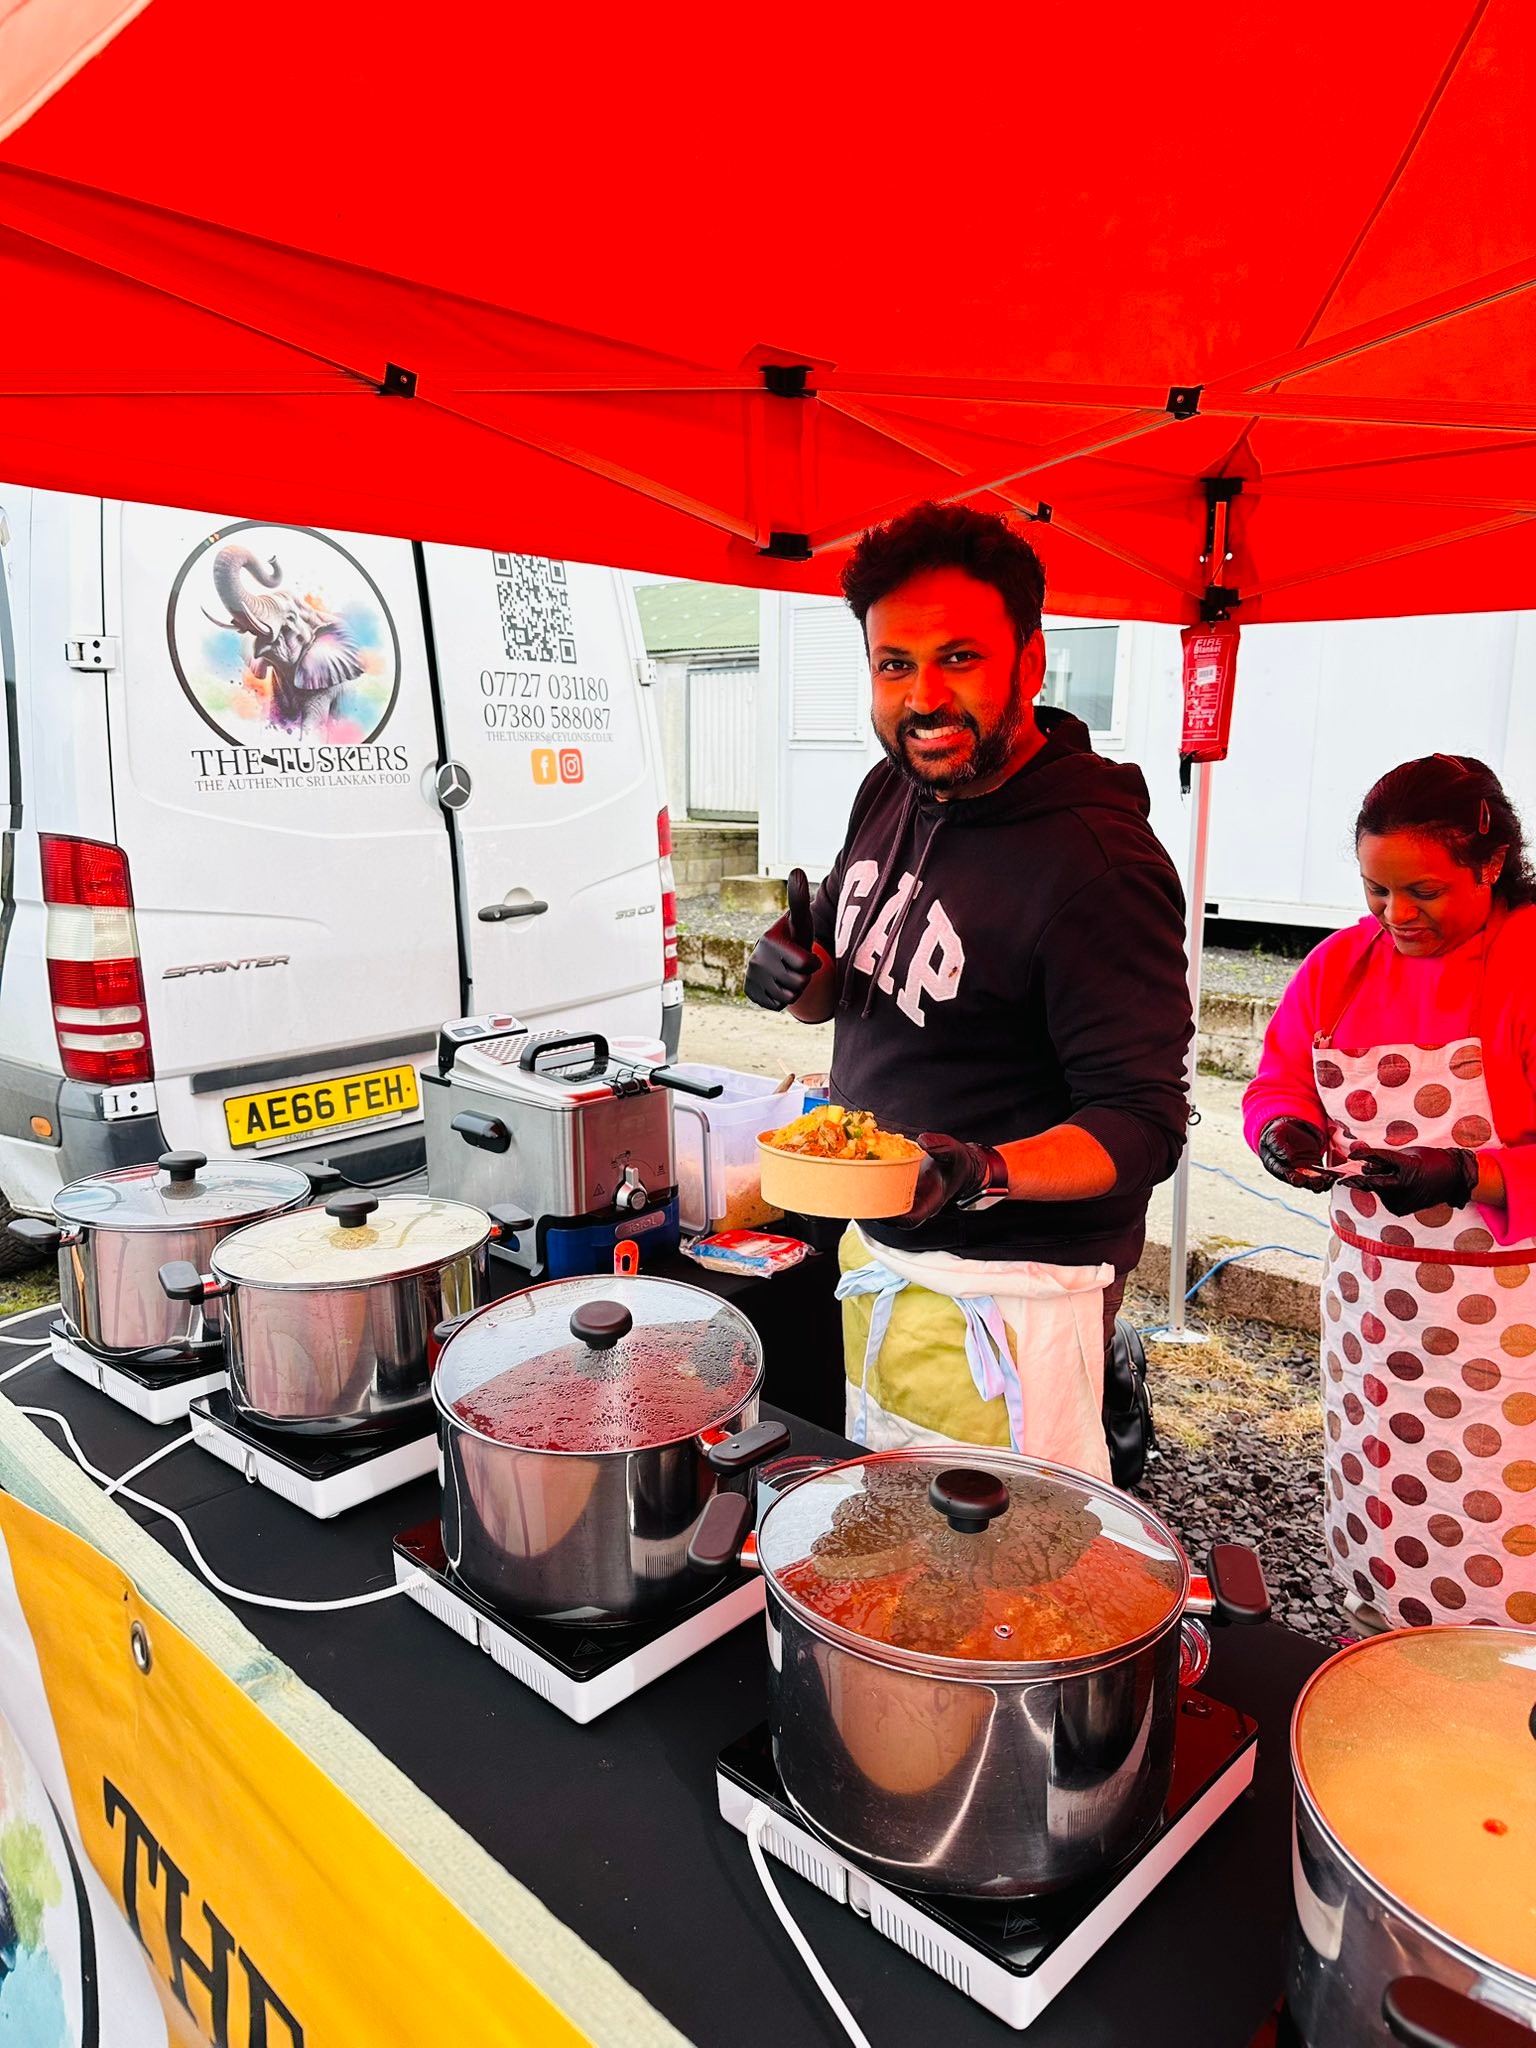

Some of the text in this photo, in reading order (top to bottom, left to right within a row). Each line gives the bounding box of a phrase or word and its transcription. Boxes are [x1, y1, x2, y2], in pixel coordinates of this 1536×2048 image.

[1196, 638, 1222, 647] FIRE
[480, 670, 609, 702] 07727 031180
[484, 703, 610, 730] 07380 588087
[191, 745, 408, 777] THE TUSKERS
[195, 773, 411, 792] THE AUTHENTIC SRI LANKAN FOOD
[834, 859, 966, 1028] GAP
[161, 954, 290, 980] SPRINTER
[246, 1074, 404, 1135] AE66 FEH
